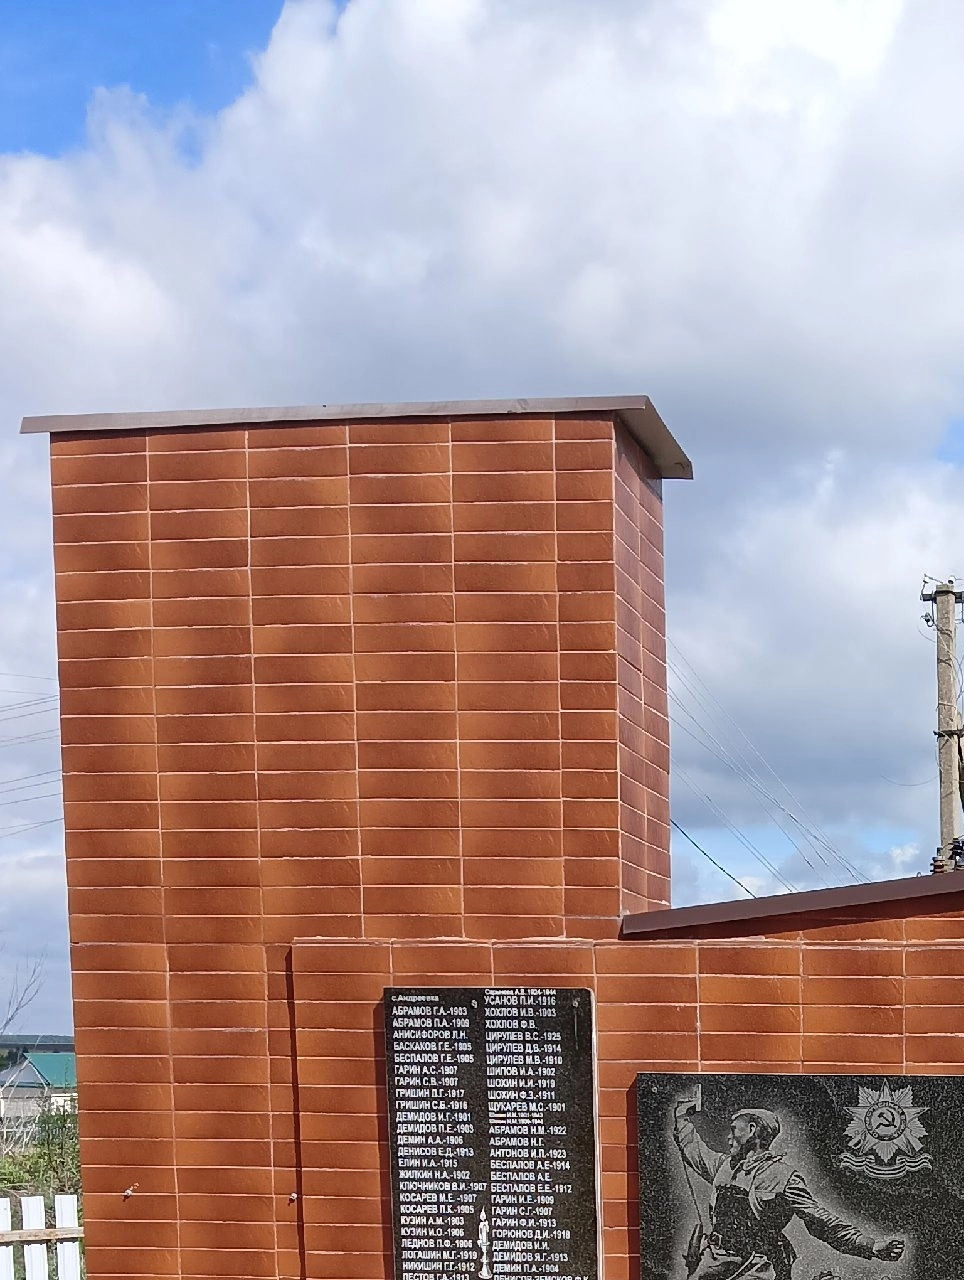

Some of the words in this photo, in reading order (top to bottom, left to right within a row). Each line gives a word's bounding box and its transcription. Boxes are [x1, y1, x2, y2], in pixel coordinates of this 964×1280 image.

[484, 996, 518, 1005] УСАНОВ
[392, 1006, 432, 1015] АБРАМОВ
[485, 1008, 518, 1016] ХОХЛОВ
[393, 1018, 432, 1027] АБРАМОВ
[485, 1020, 518, 1028] ХОХЛОВ
[393, 1030, 450, 1038] АНИСИФОРОВ
[486, 1032, 523, 1042] ЦИРУЛЕВ
[394, 1042, 436, 1050] БАСКАКОВ
[486, 1043, 523, 1052] ЦИРУЛЕВ
[395, 1053, 438, 1062] БЕСПАЛОВ
[486, 1055, 524, 1065] ЦИРУЛЕВ
[395, 1065, 420, 1074] ГАРИН
[422, 1066, 457, 1074] А.С.-1907
[487, 1067, 518, 1075] ШИПОВ
[395, 1077, 420, 1085] ГАРИН
[487, 1079, 517, 1087] ШОХИН
[396, 1089, 429, 1097] ГРИШИН
[488, 1091, 518, 1099] ШОХИН
[396, 1101, 430, 1109] ГРИШИН
[488, 1102, 528, 1111] ЩУКАРЕВ
[396, 1112, 436, 1122] ДЕМИДОВ
[438, 1112, 471, 1121] И.Г.-1901
[397, 1124, 437, 1134] ДЕМИДОВ
[489, 1126, 528, 1134] АБРАМОВ
[397, 1136, 425, 1145] ДЕМИН
[489, 1138, 529, 1146] АБРАМОВ
[398, 1147, 437, 1157] ДЕНИСОВ
[490, 1149, 529, 1157] АНТОНОВ
[399, 1159, 420, 1167] ЕЛИН
[422, 1159, 457, 1167] И.А.-1915
[491, 1160, 534, 1169] БЕСПАЛОВ
[399, 1170, 432, 1179] ЖИЛКИН
[435, 1171, 470, 1179] Н.А.-1902
[491, 1172, 535, 1180] БЕСПАЛОВ
[400, 1182, 450, 1190] КЛЮЧНИКОВ
[491, 1183, 535, 1192] БЕСПАЛОВ
[400, 1193, 437, 1202] КОСАРЕВ
[491, 1195, 517, 1203] ГАРИН
[400, 1205, 438, 1213] КОСАРЕВ
[492, 1207, 517, 1215] ГАРИН
[401, 1216, 426, 1224] КУЗИН
[492, 1218, 518, 1226] ГАРИН
[401, 1227, 427, 1235] КУЗИН
[492, 1230, 533, 1238] ГОРЮНОВ
[401, 1239, 434, 1249] ЛЕДНОВ
[492, 1241, 532, 1251] ДЕМИДОВ
[402, 1251, 441, 1259] ЛОГАШИН
[493, 1252, 533, 1261] ДЕМИДОВ
[403, 1262, 442, 1270] НИКИШИН
[493, 1264, 521, 1273] ДЕМИН
[403, 1273, 434, 1280] ПЕСТОВ
